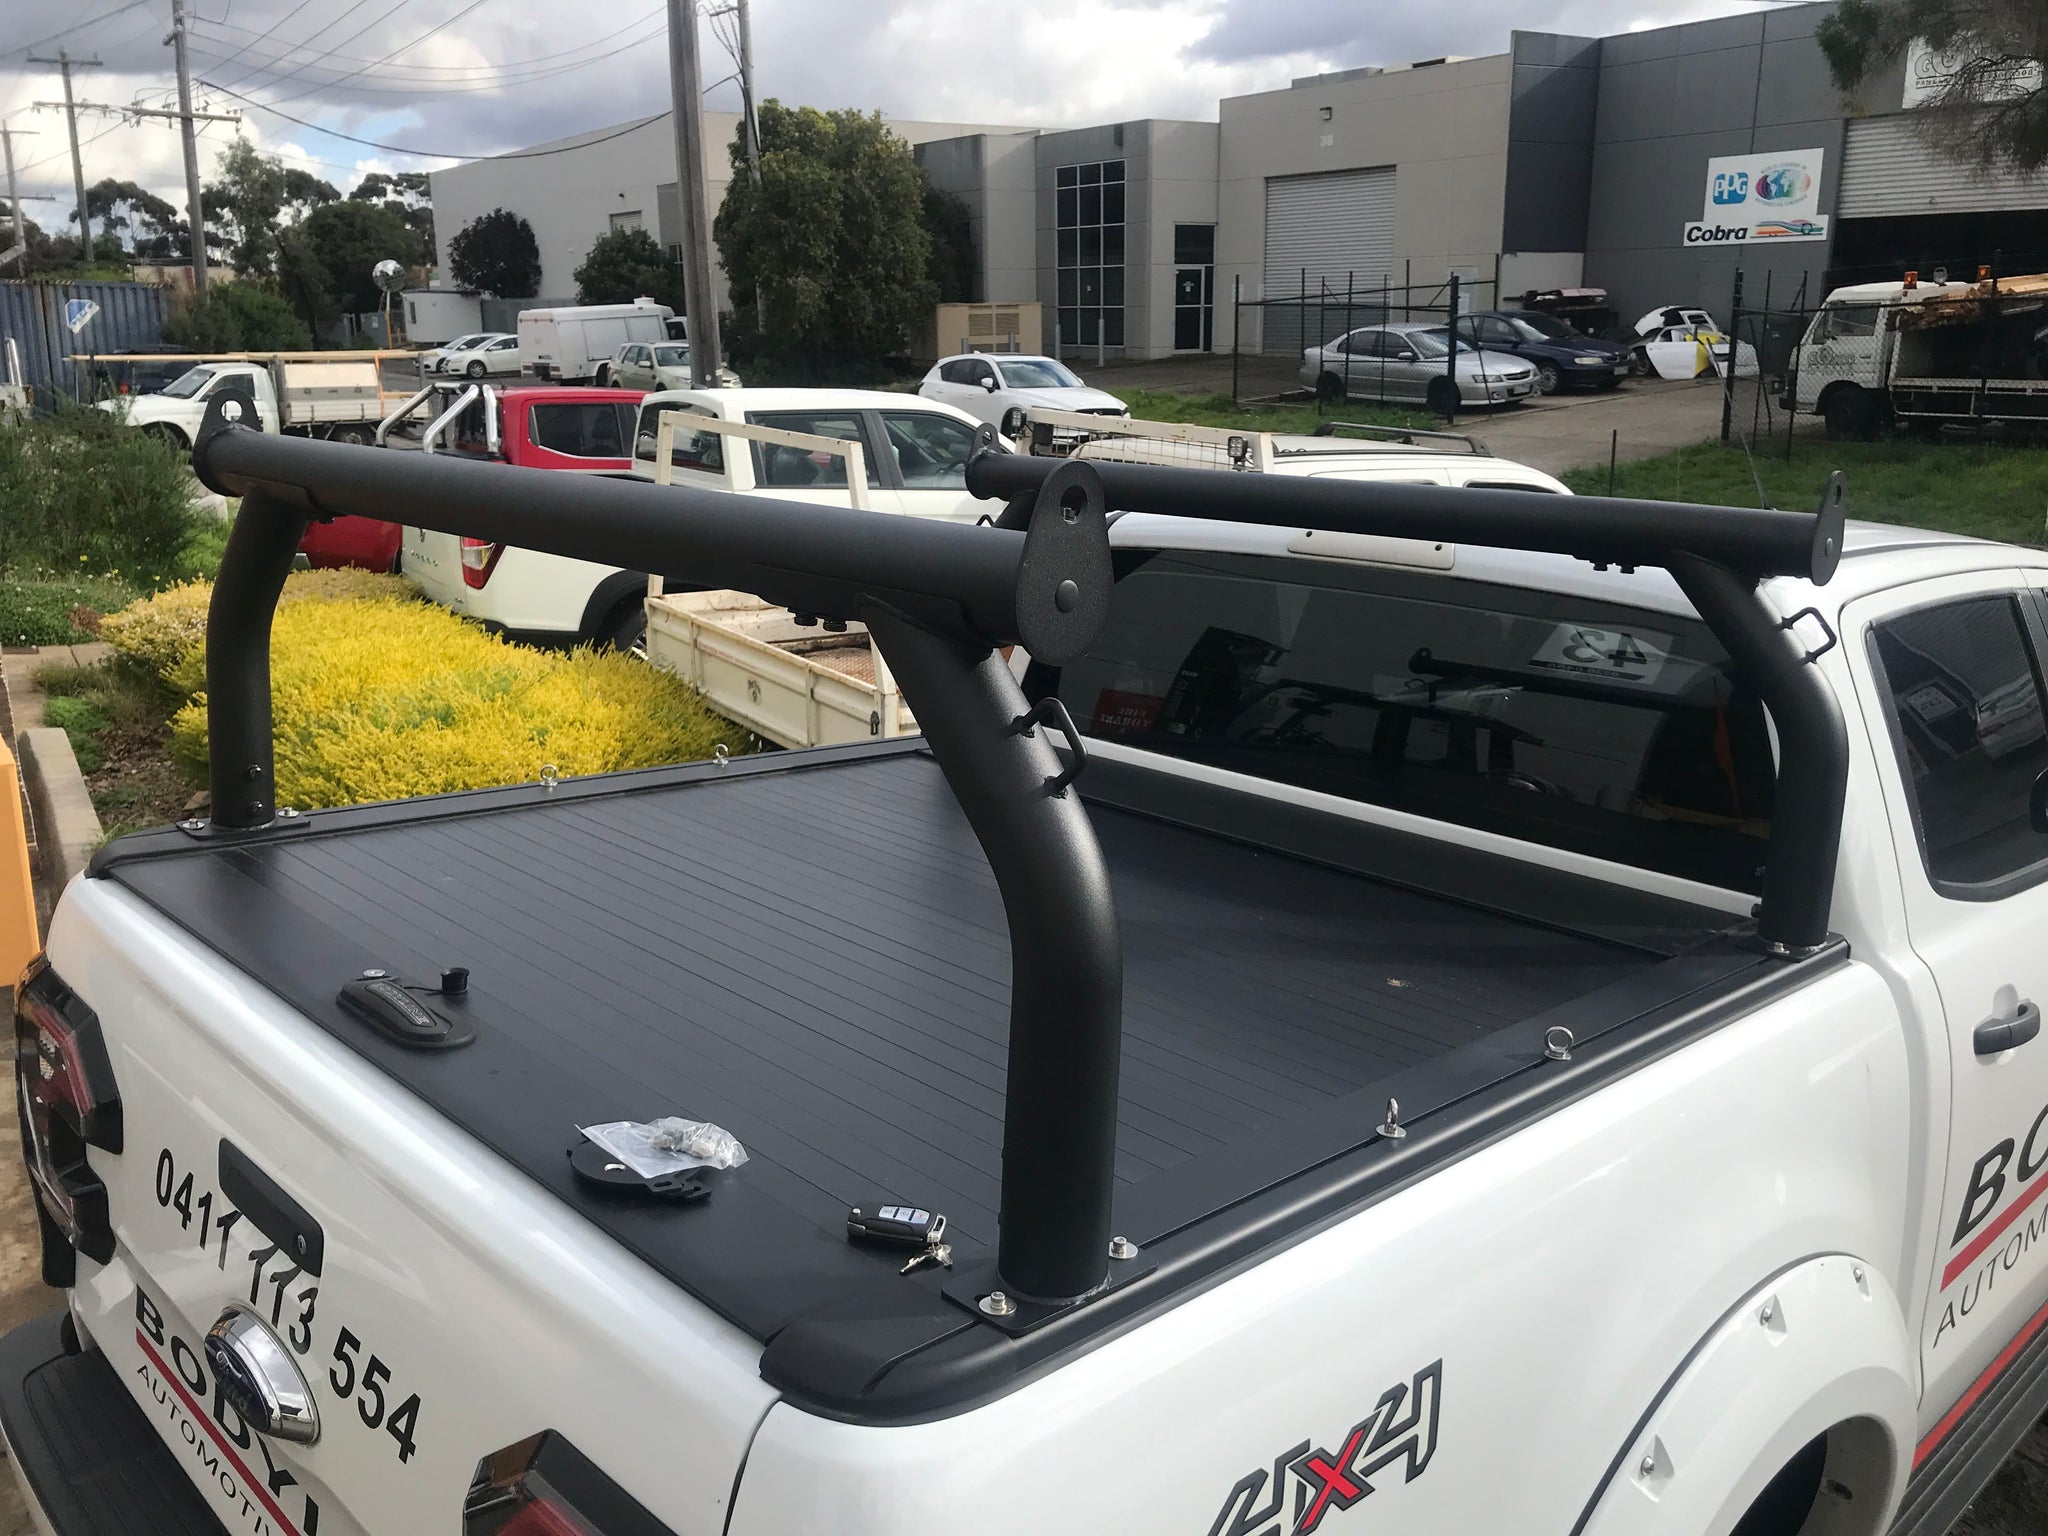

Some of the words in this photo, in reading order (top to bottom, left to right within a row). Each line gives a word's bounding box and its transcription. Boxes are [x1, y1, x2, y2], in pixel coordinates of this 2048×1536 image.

[1713, 172, 1749, 201] PPG
[1686, 225, 1748, 243] Cobra
[156, 1148, 243, 1271] 0411
[329, 1325, 421, 1464] 554
